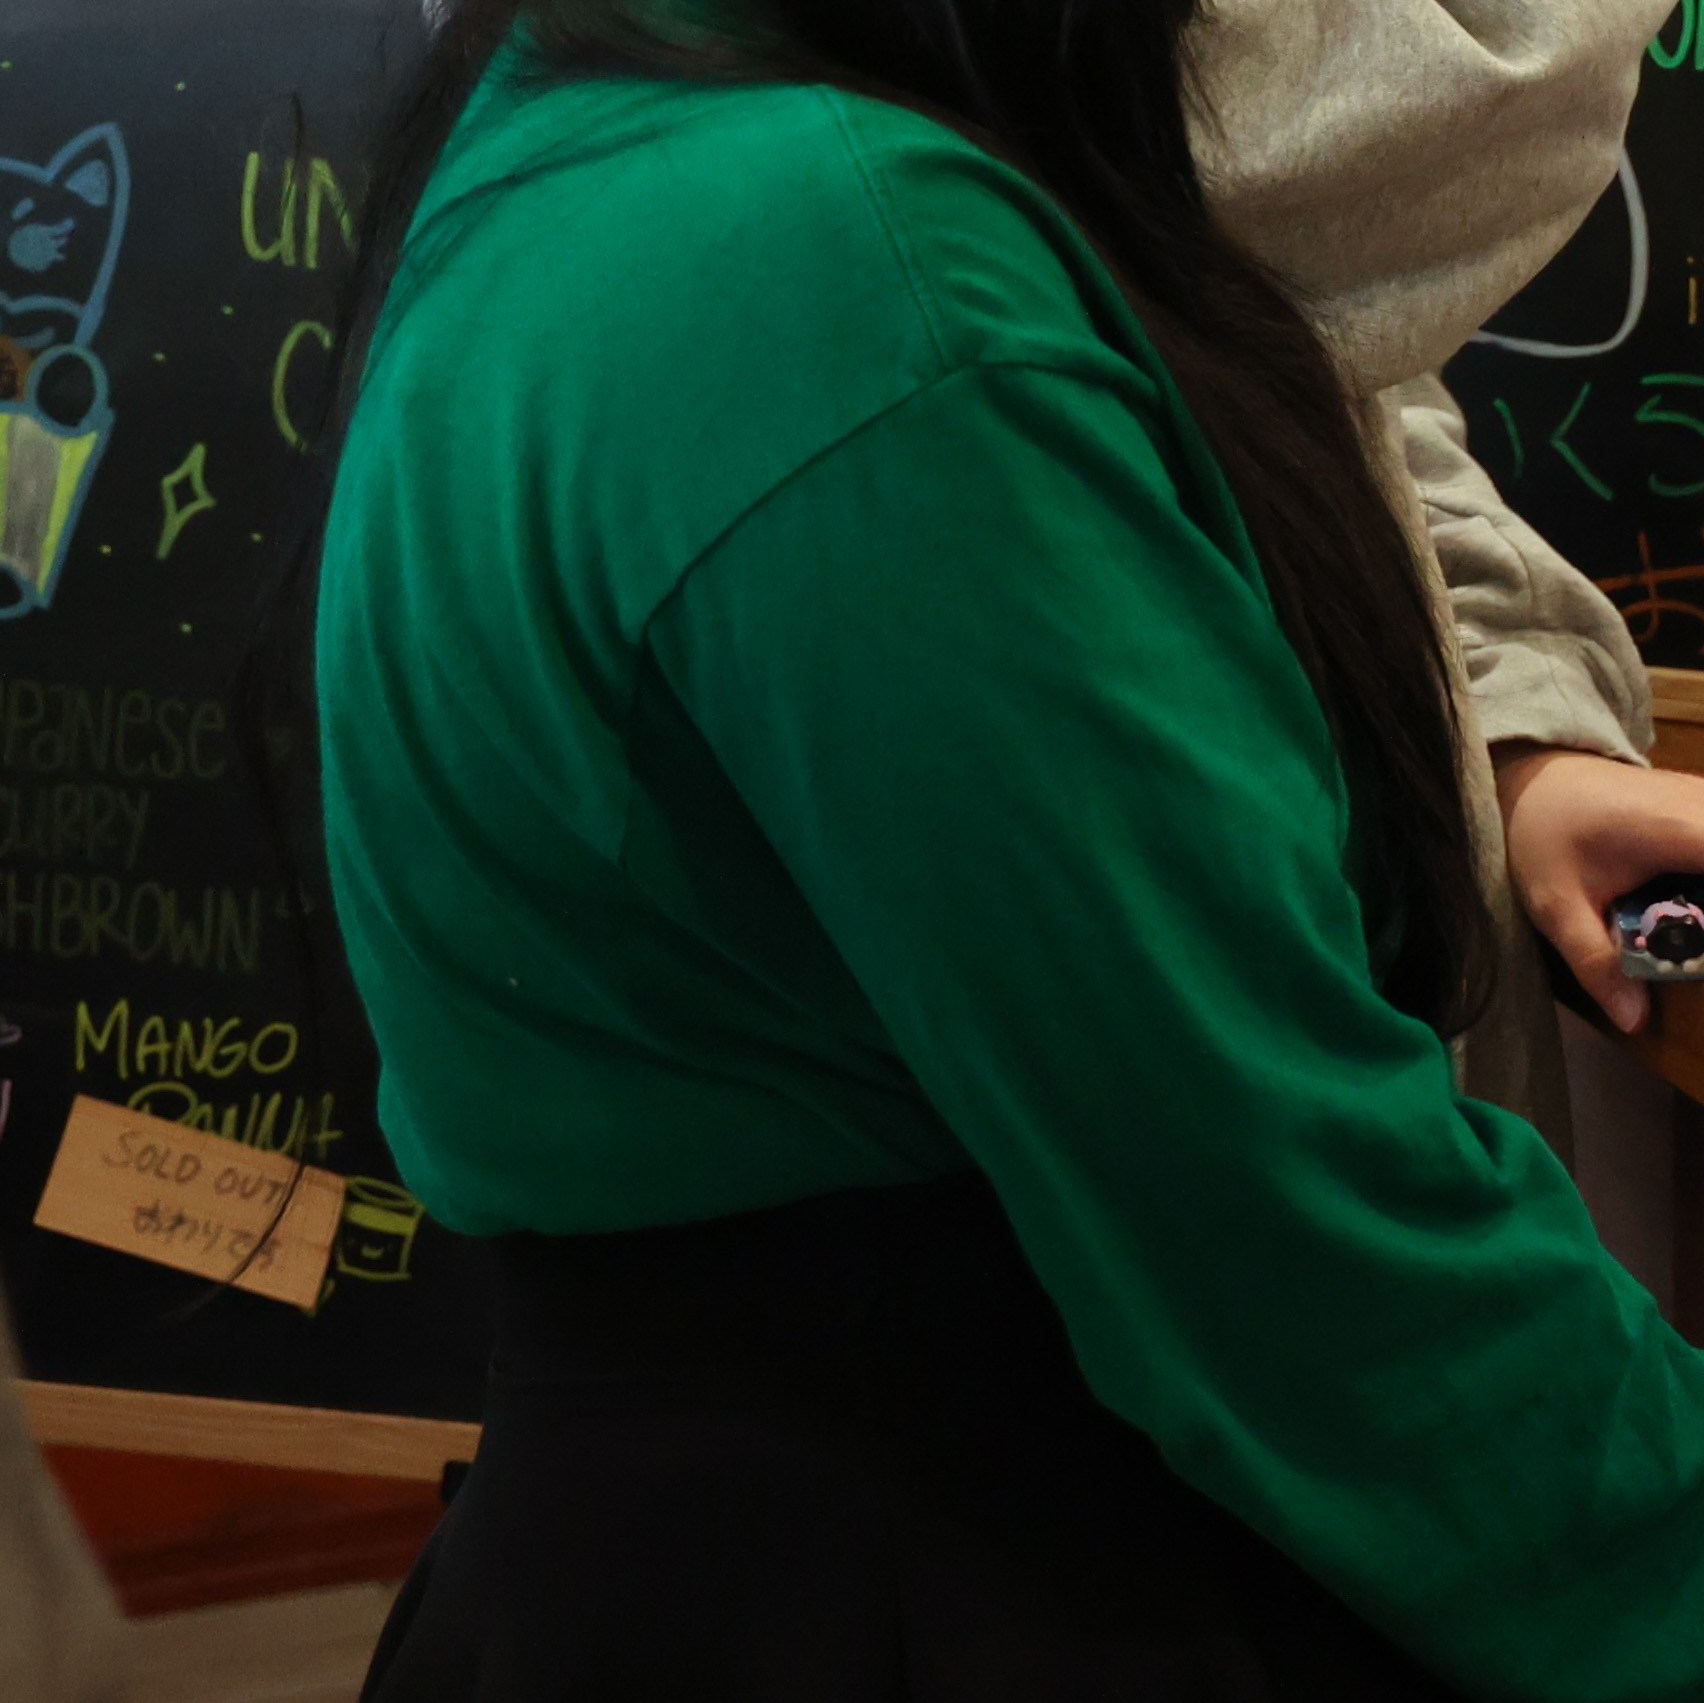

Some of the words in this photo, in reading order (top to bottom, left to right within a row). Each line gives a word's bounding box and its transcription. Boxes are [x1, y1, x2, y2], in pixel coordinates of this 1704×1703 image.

[75, 998, 299, 1080] MANGO
[102, 1129, 204, 1186] SOLD
[212, 1166, 284, 1208] OUT
